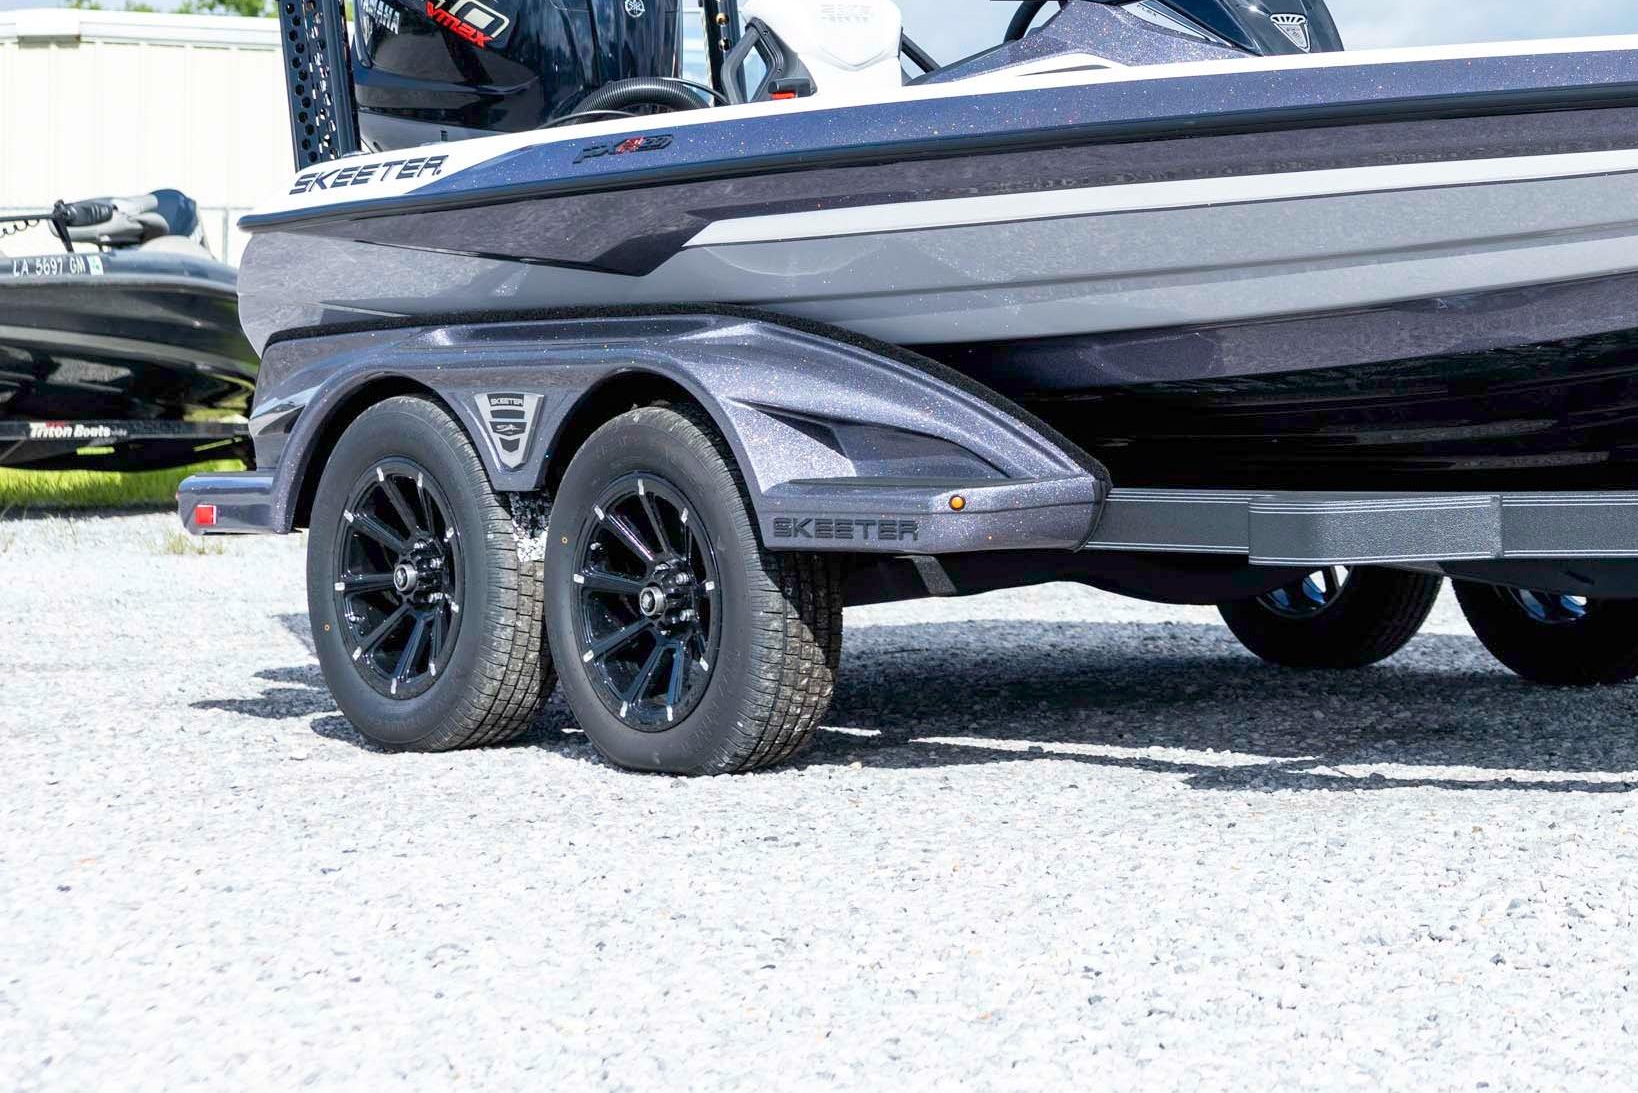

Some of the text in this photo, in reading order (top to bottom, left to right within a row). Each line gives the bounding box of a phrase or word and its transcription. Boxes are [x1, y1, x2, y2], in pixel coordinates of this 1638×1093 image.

[289, 155, 449, 195] SKEETER
[13, 255, 87, 277] LA 5697 GM
[490, 397, 524, 406] SKEETER
[28, 421, 73, 439] Triton
[73, 424, 112, 439] Boats
[772, 517, 919, 541] SKEETER
